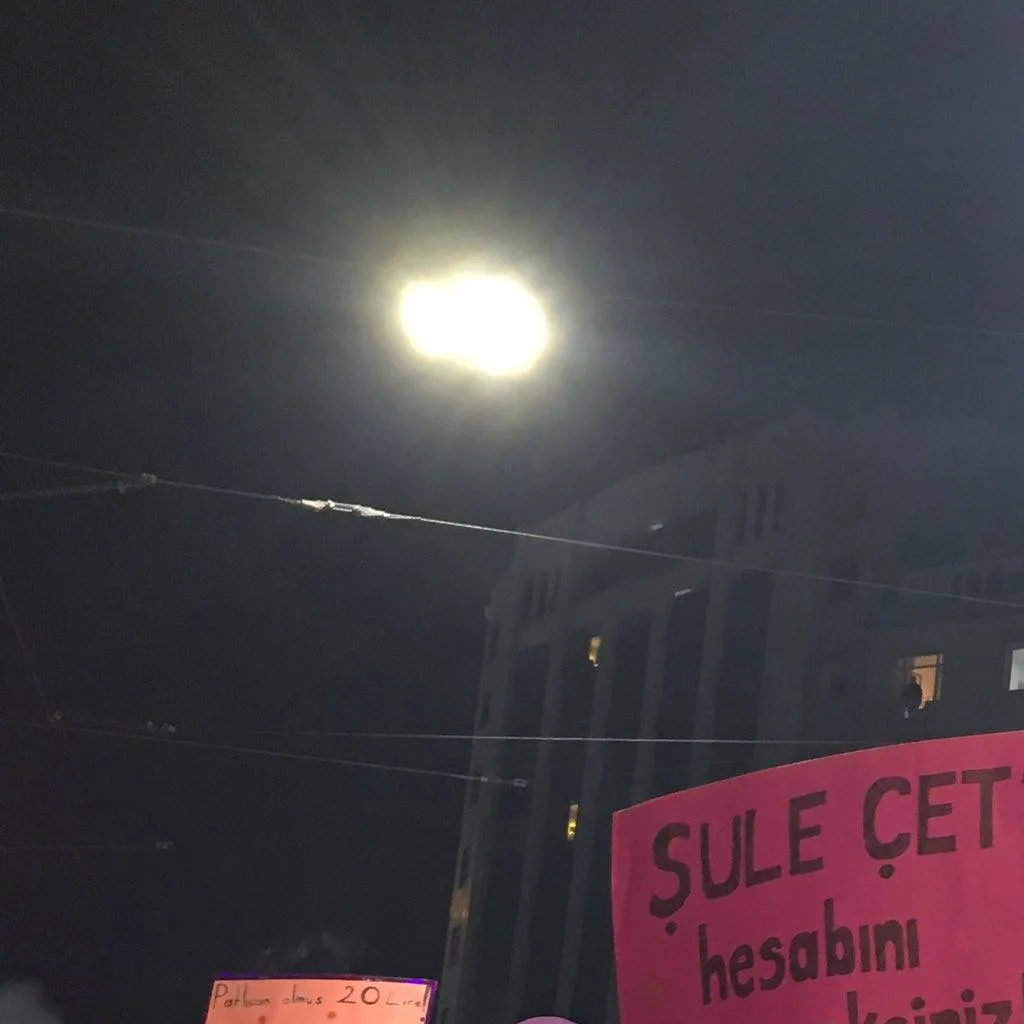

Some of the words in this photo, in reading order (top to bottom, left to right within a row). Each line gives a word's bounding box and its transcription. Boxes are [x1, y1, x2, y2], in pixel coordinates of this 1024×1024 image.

[649, 790, 827, 935] ŞULE
[337, 985, 381, 1006] 20
[698, 898, 920, 1006] hesabını
